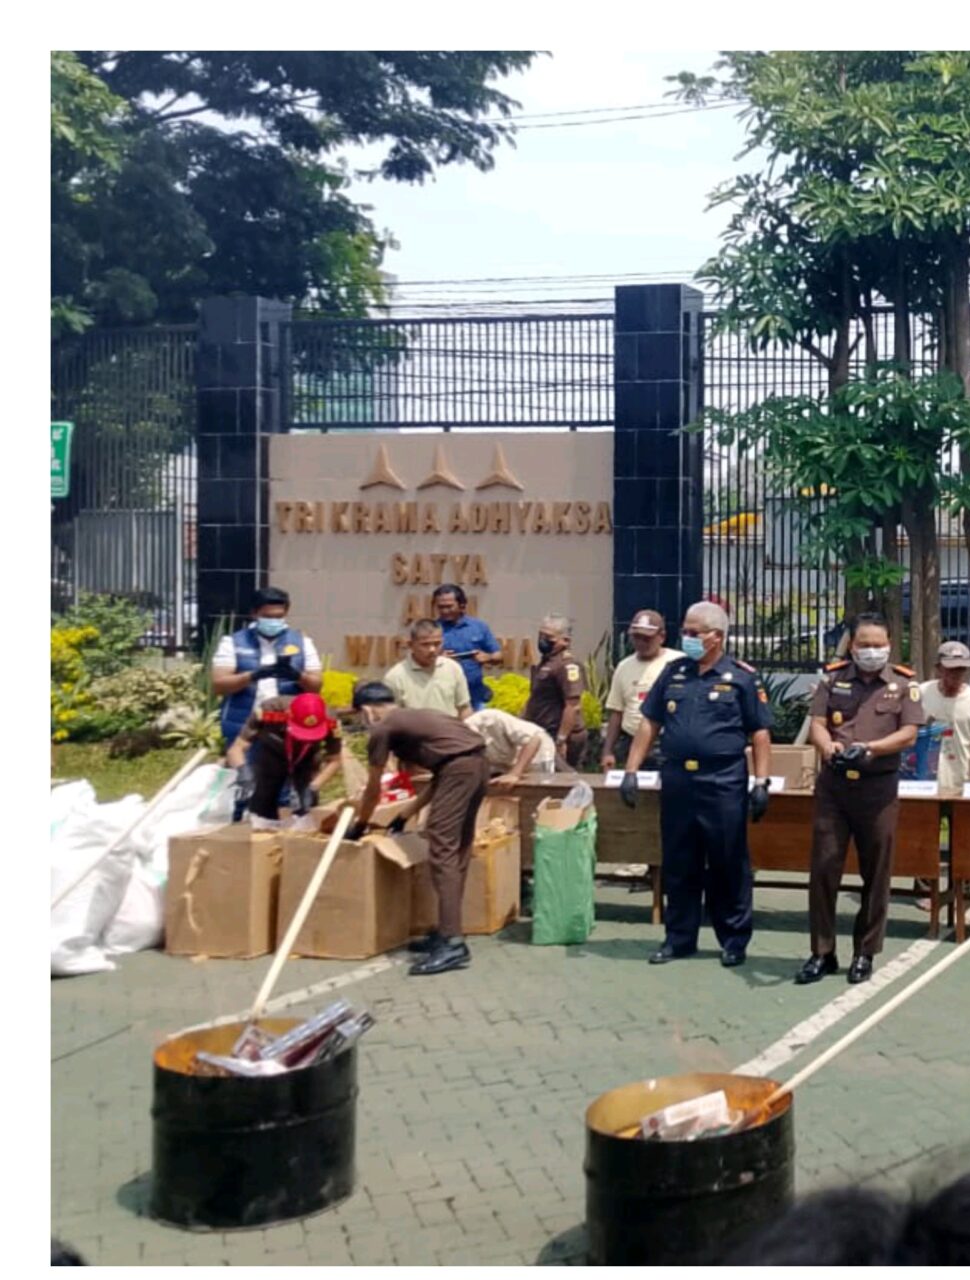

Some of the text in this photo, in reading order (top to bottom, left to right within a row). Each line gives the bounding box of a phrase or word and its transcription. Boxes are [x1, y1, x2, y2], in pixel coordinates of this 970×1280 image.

[276, 500, 614, 536] TRI KRAMA ADHYAKSA
[391, 553, 488, 586] SATYA
